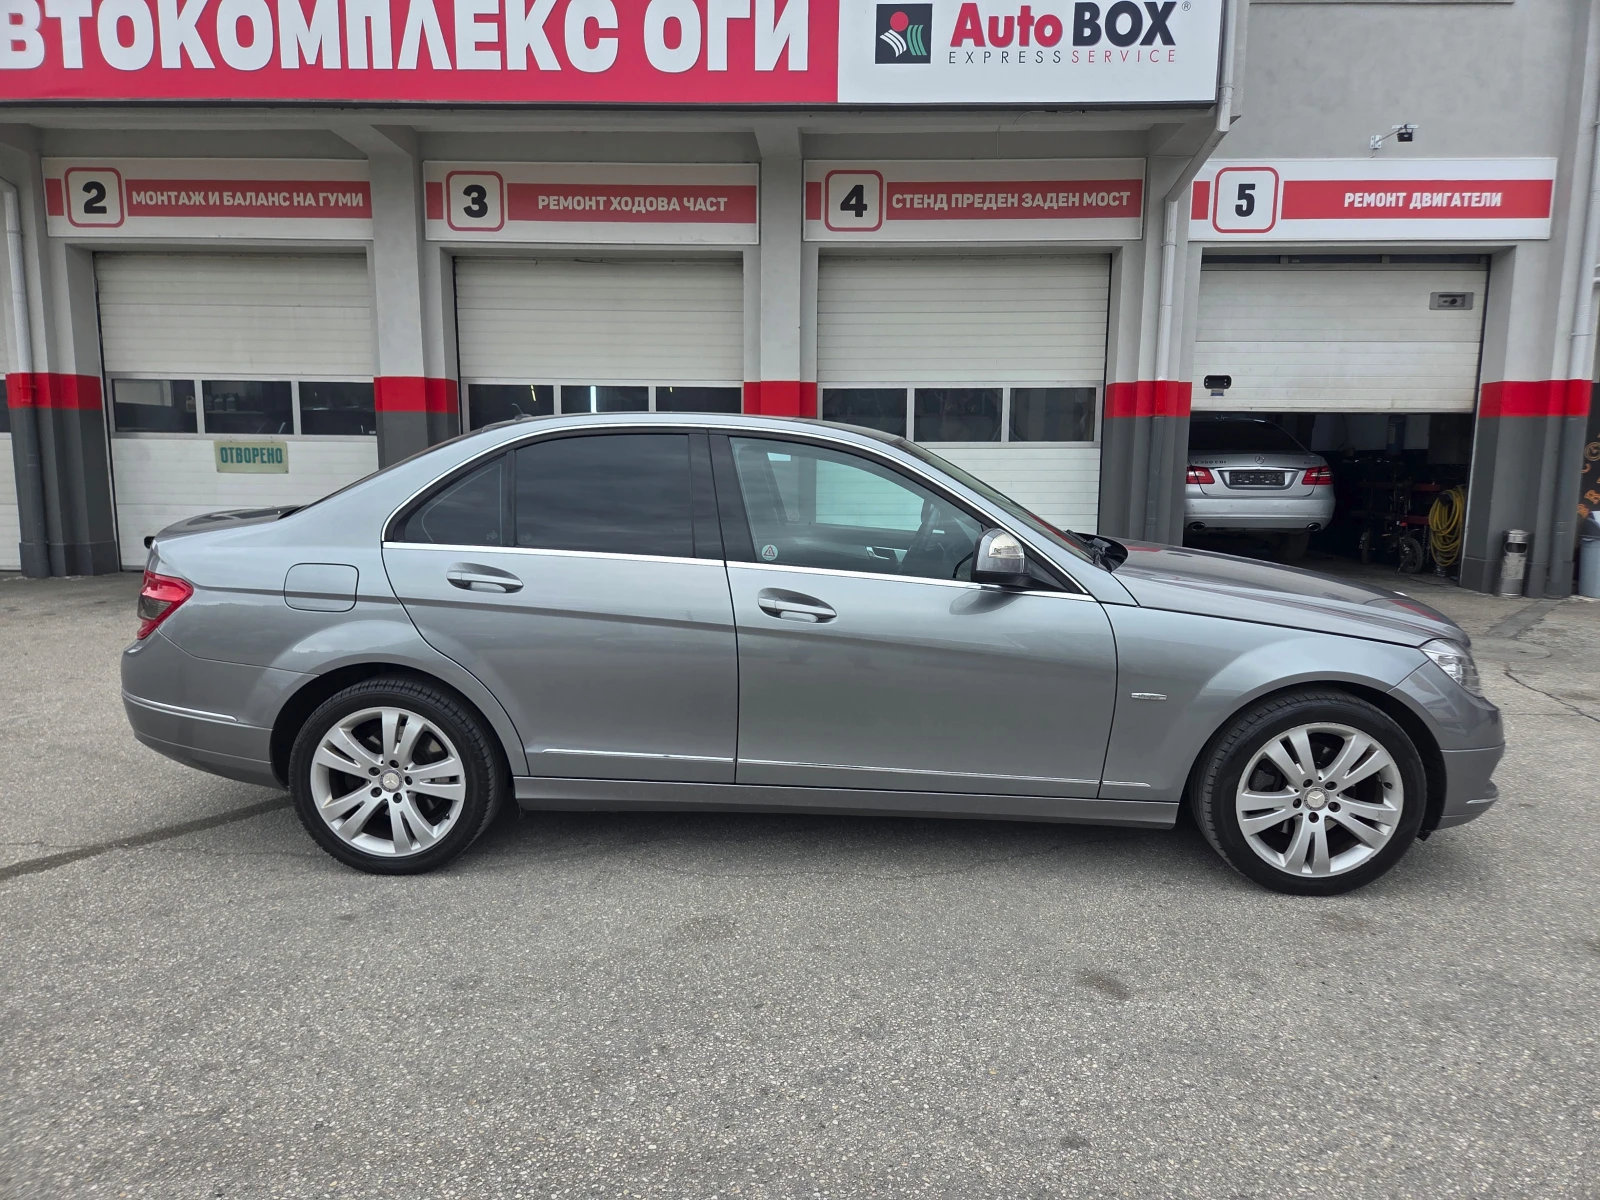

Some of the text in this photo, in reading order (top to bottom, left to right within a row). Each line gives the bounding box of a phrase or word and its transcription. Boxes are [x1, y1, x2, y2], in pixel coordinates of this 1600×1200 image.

[0, 0, 808, 72] ВТОКОМПЛЕКС ОГИ
[950, 0, 1177, 48] Auto BOX
[82, 181, 363, 215] 2 МОНТАЖ И БАЛАНС НА ГУМИ
[462, 184, 728, 219] 3 РЕМОНТ ХОДОВА ЧАСТ
[839, 184, 1131, 218] 4 СТЕНД ПРЕДЕН ЗАДЕН МОСТ
[1234, 183, 1503, 218] 5 РЕМОНТ ДВИГАТЕЛИ
[220, 446, 283, 464] ОТВОРЕНО
